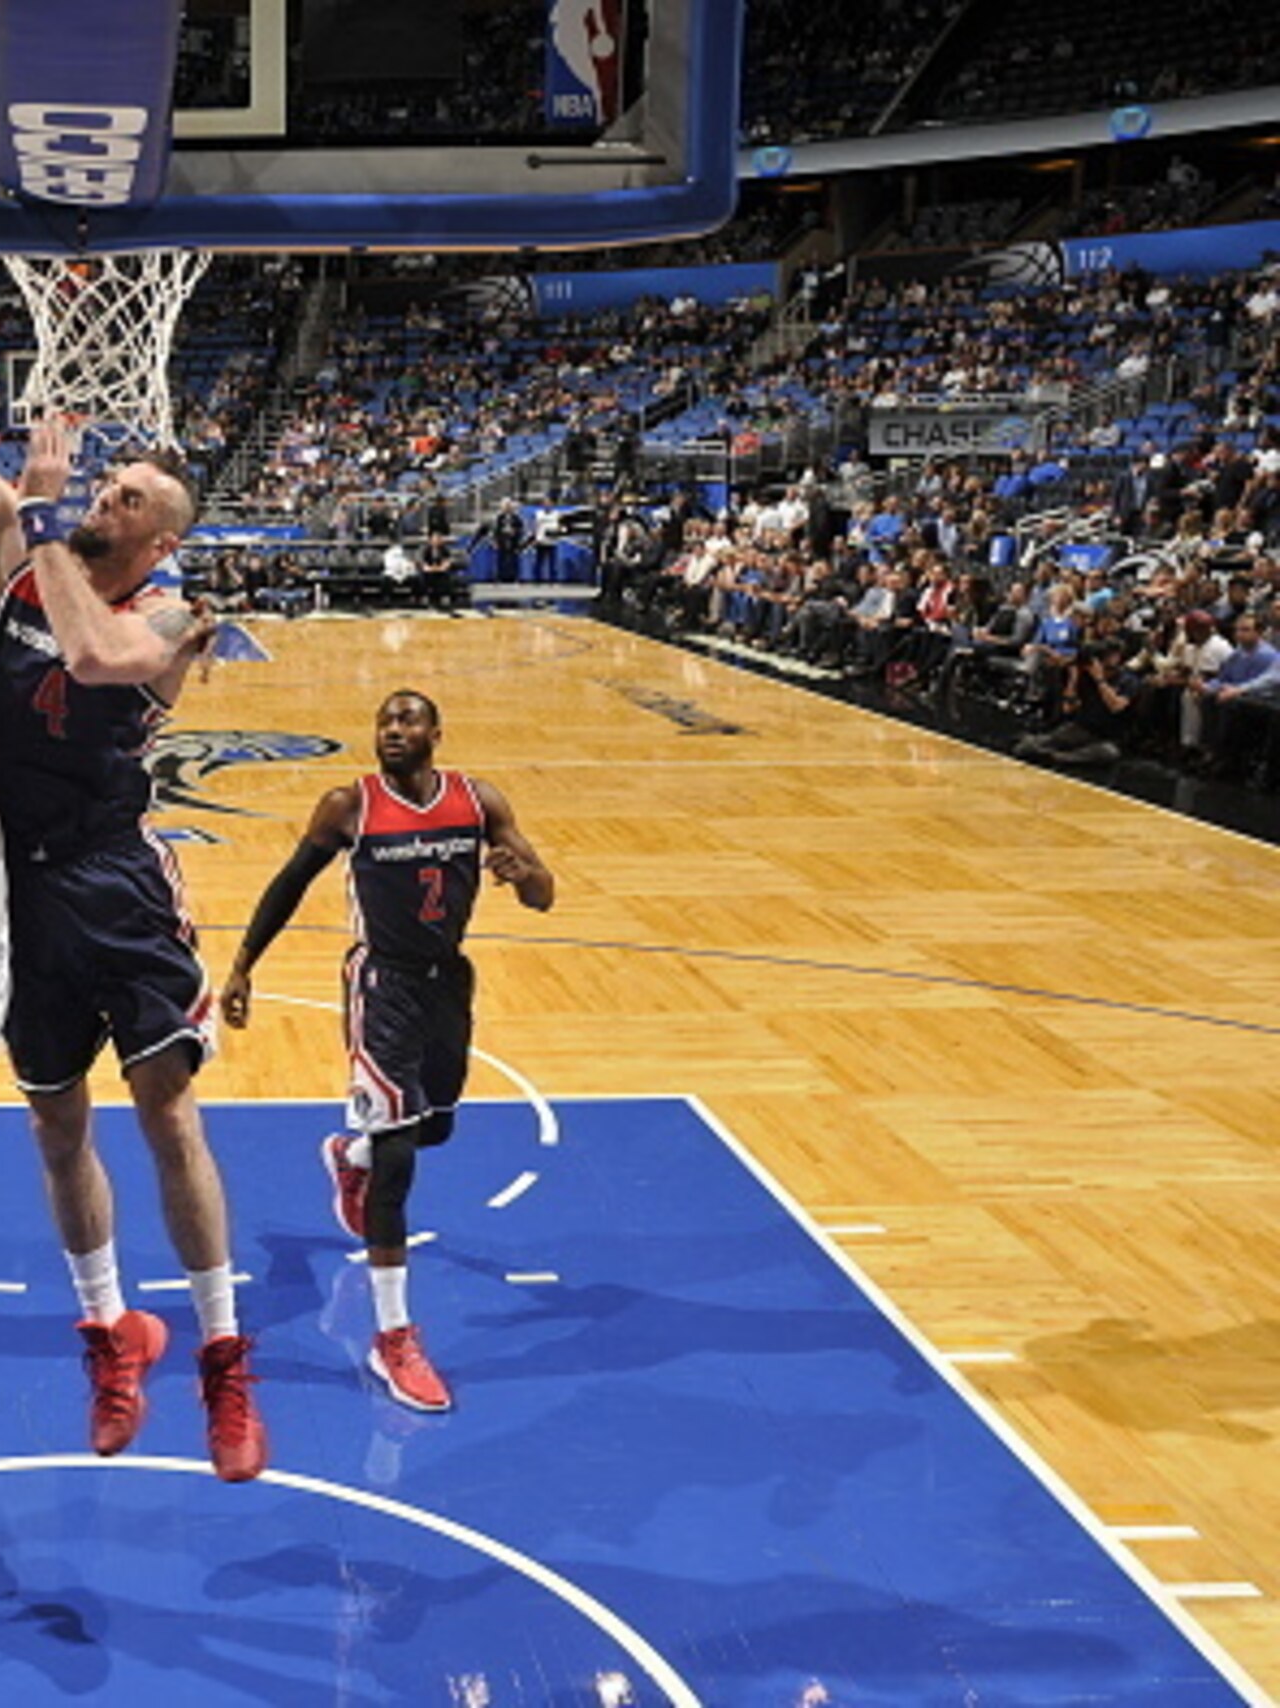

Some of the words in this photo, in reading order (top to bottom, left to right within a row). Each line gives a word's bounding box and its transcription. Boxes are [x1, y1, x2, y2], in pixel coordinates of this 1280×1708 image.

[552, 93, 593, 119] NBA
[33, 665, 68, 738] 4
[417, 867, 448, 922] 2
